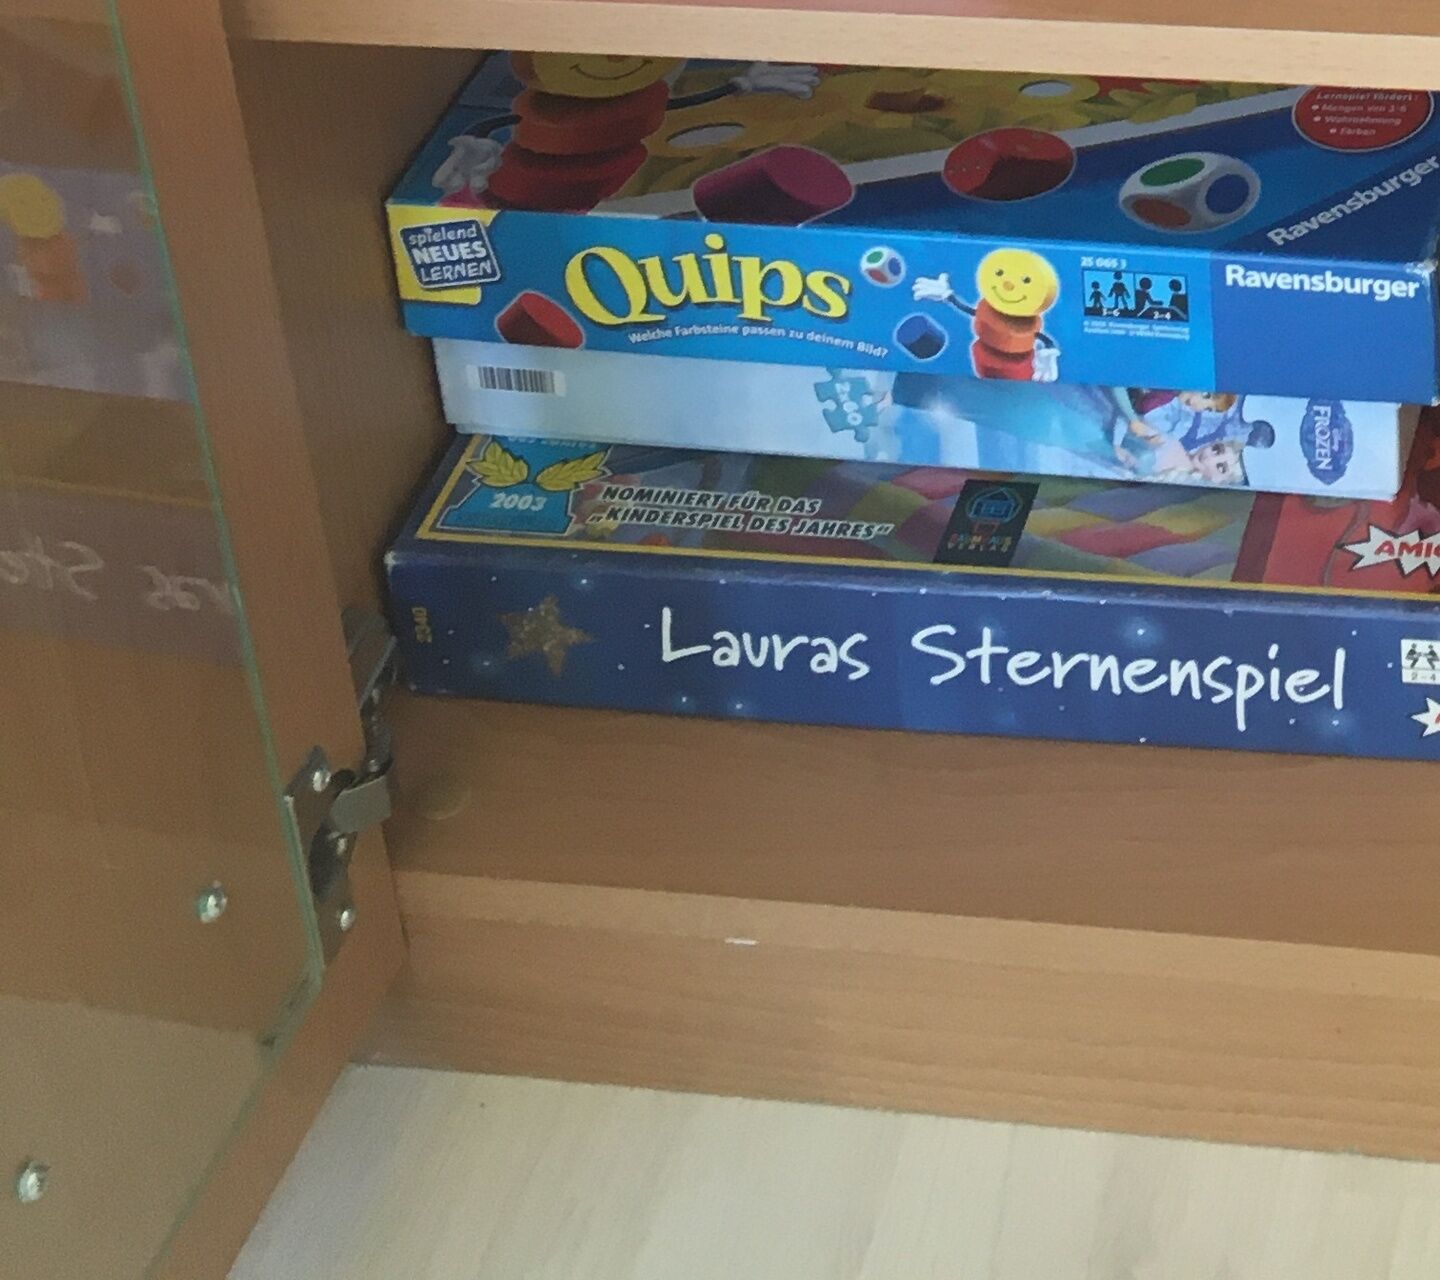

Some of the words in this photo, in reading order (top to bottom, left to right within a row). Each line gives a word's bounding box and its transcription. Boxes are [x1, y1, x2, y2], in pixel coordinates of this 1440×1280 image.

[408, 224, 477, 247] spielend
[411, 242, 488, 265] NEUES
[420, 259, 493, 283] LERNEN
[565, 234, 851, 326] Quips
[1224, 265, 1421, 300] Ravensburger
[627, 325, 673, 343] Welche
[674, 321, 739, 338] Farbsteine
[742, 324, 785, 339] passen
[788, 329, 804, 340] zu
[805, 328, 854, 350] deinem
[856, 340, 889, 359] Bild?
[1312, 405, 1333, 470] FROZEN
[490, 493, 547, 512] 2003
[602, 484, 725, 507] NOMINIERT
[727, 489, 774, 510] FÜR
[778, 492, 822, 514] DAS
[751, 514, 793, 534] DES
[662, 607, 870, 681] Lauras
[911, 624, 1346, 732] Sternenspiel
